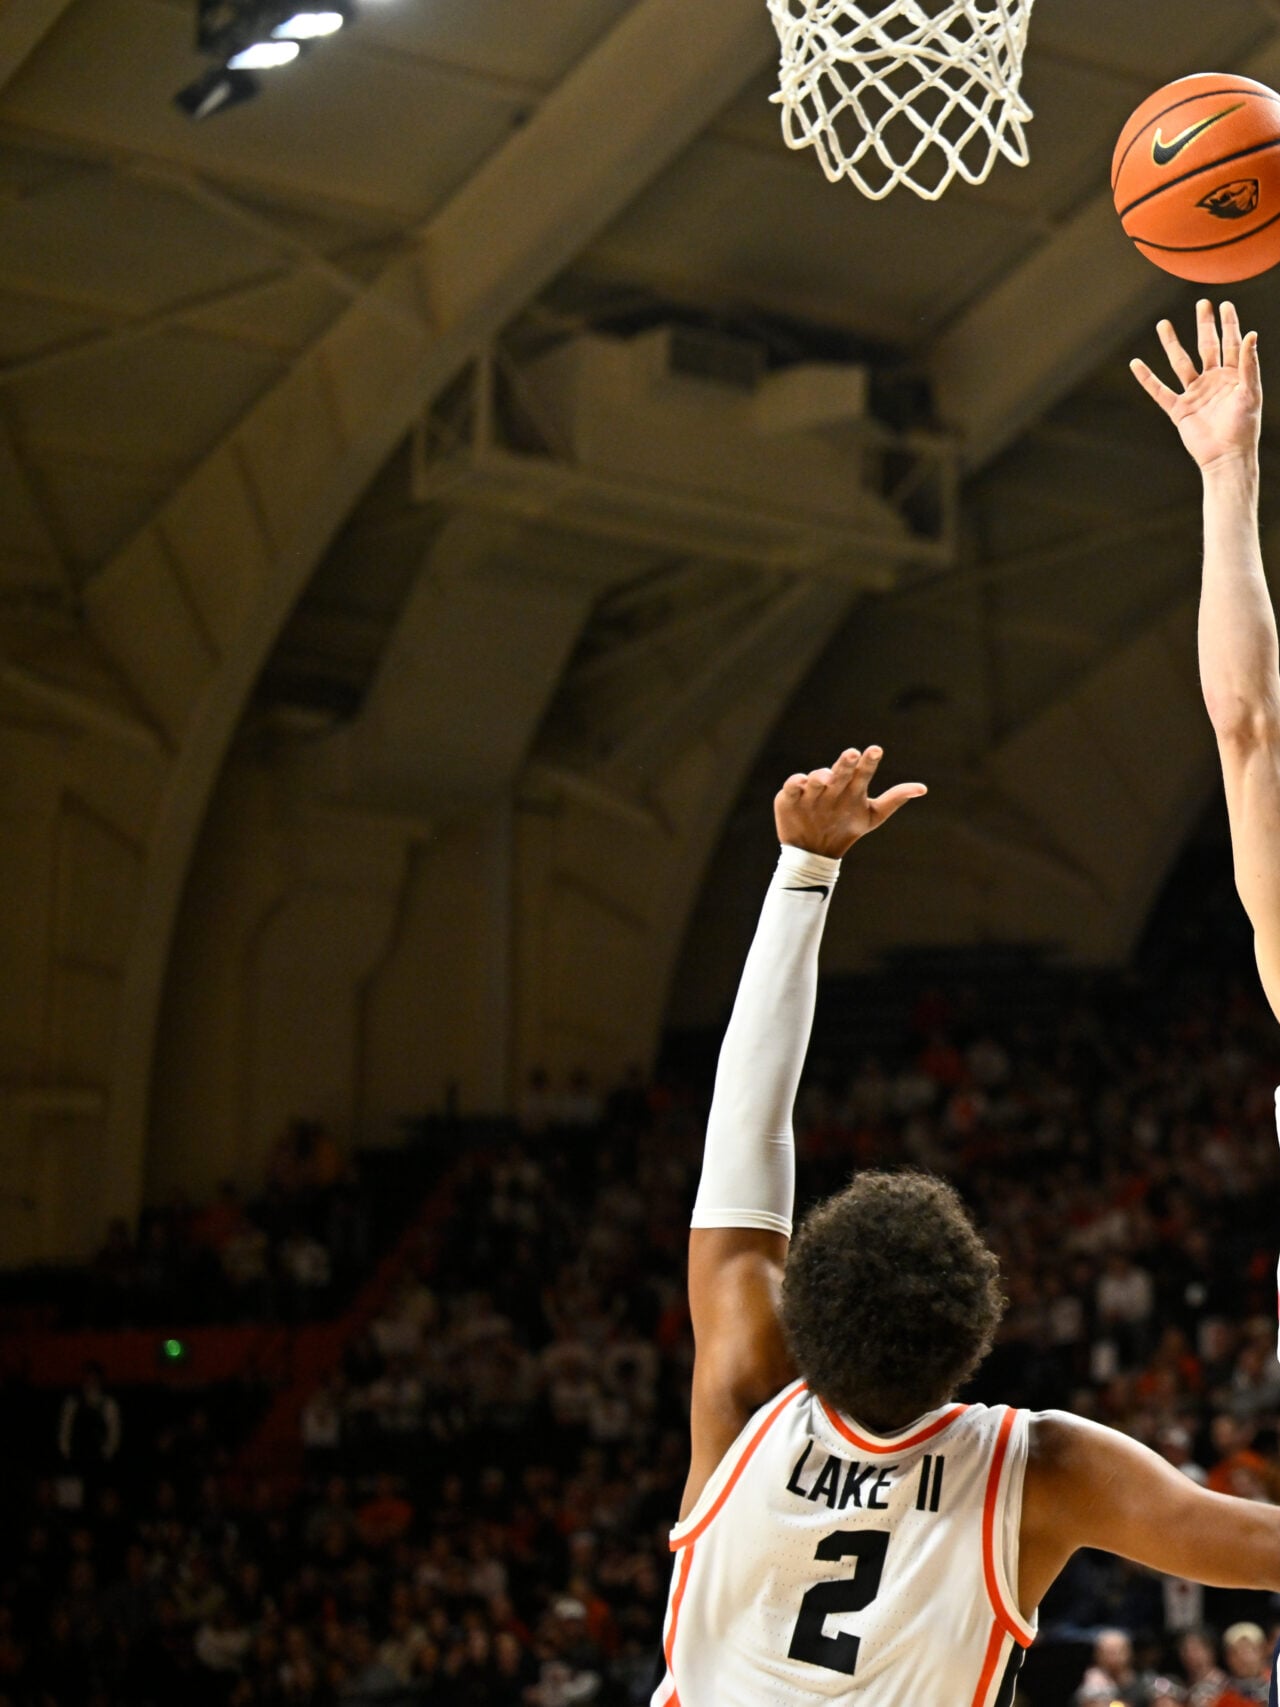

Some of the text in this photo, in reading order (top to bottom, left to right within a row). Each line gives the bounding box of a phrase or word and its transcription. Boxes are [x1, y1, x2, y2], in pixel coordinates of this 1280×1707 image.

[786, 1439, 945, 1512] LAKE II
[787, 1529, 891, 1676] 2
